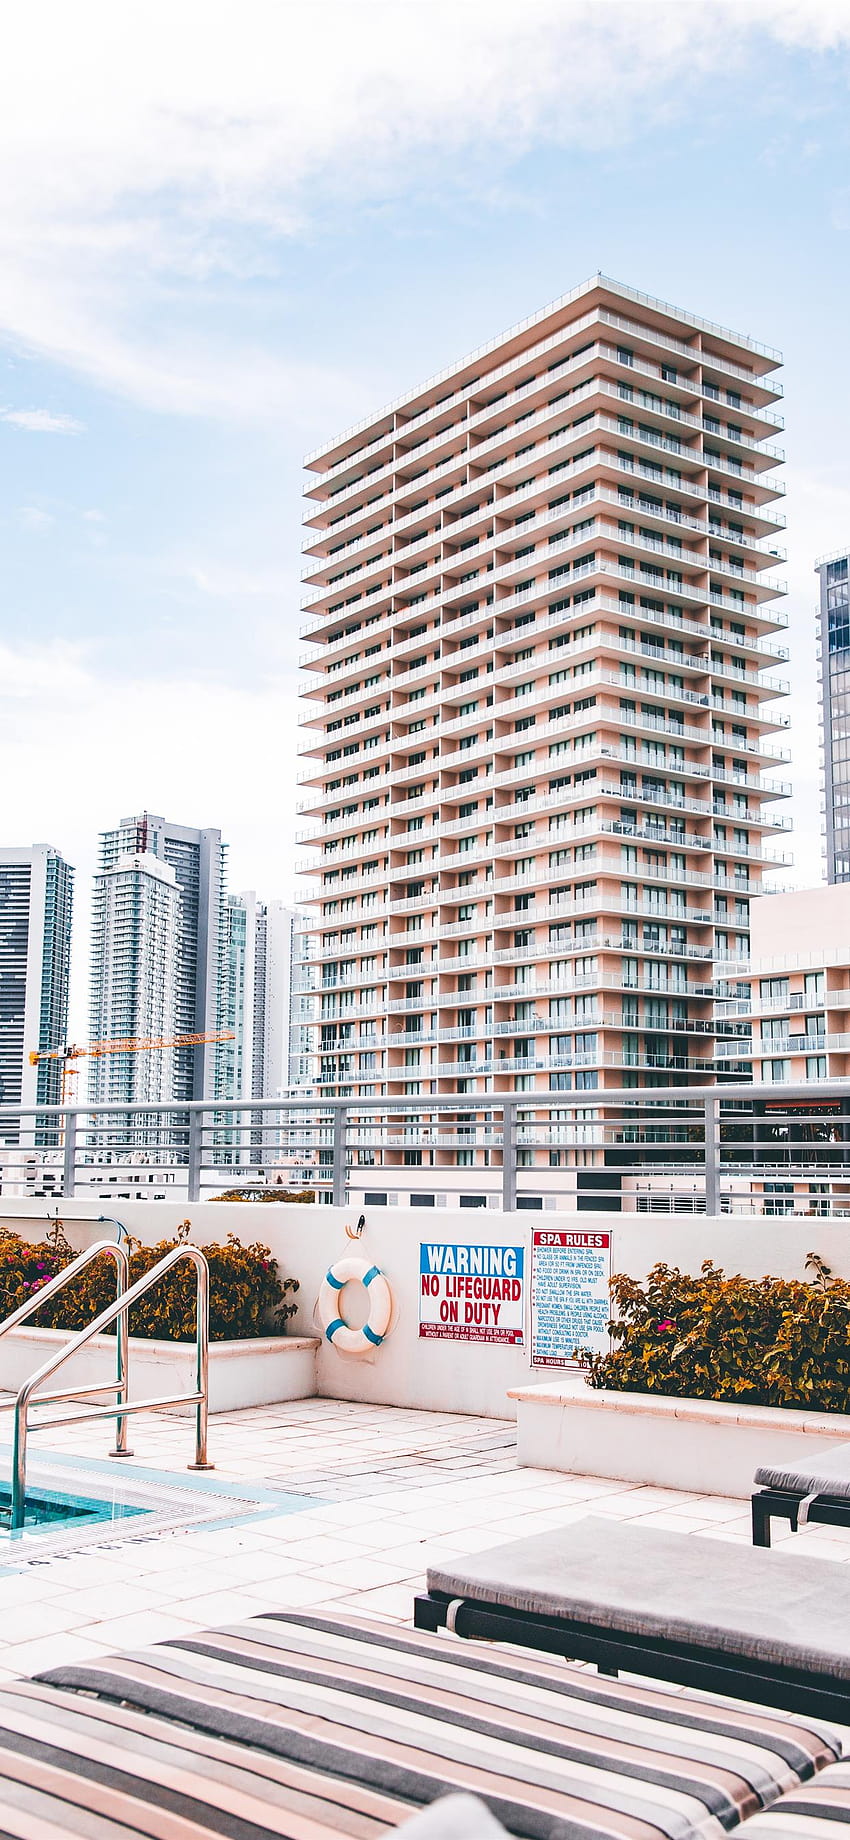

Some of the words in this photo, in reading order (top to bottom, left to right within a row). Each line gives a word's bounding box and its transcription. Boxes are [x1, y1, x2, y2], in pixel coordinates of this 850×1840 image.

[540, 1233, 562, 1244] SPA
[566, 1235, 602, 1246] RULES
[427, 1246, 516, 1276] WARNING
[422, 1275, 439, 1296] NO
[446, 1276, 521, 1301] LIFEGUARD
[440, 1300, 458, 1322] ON
[465, 1302, 501, 1325] DUTY
